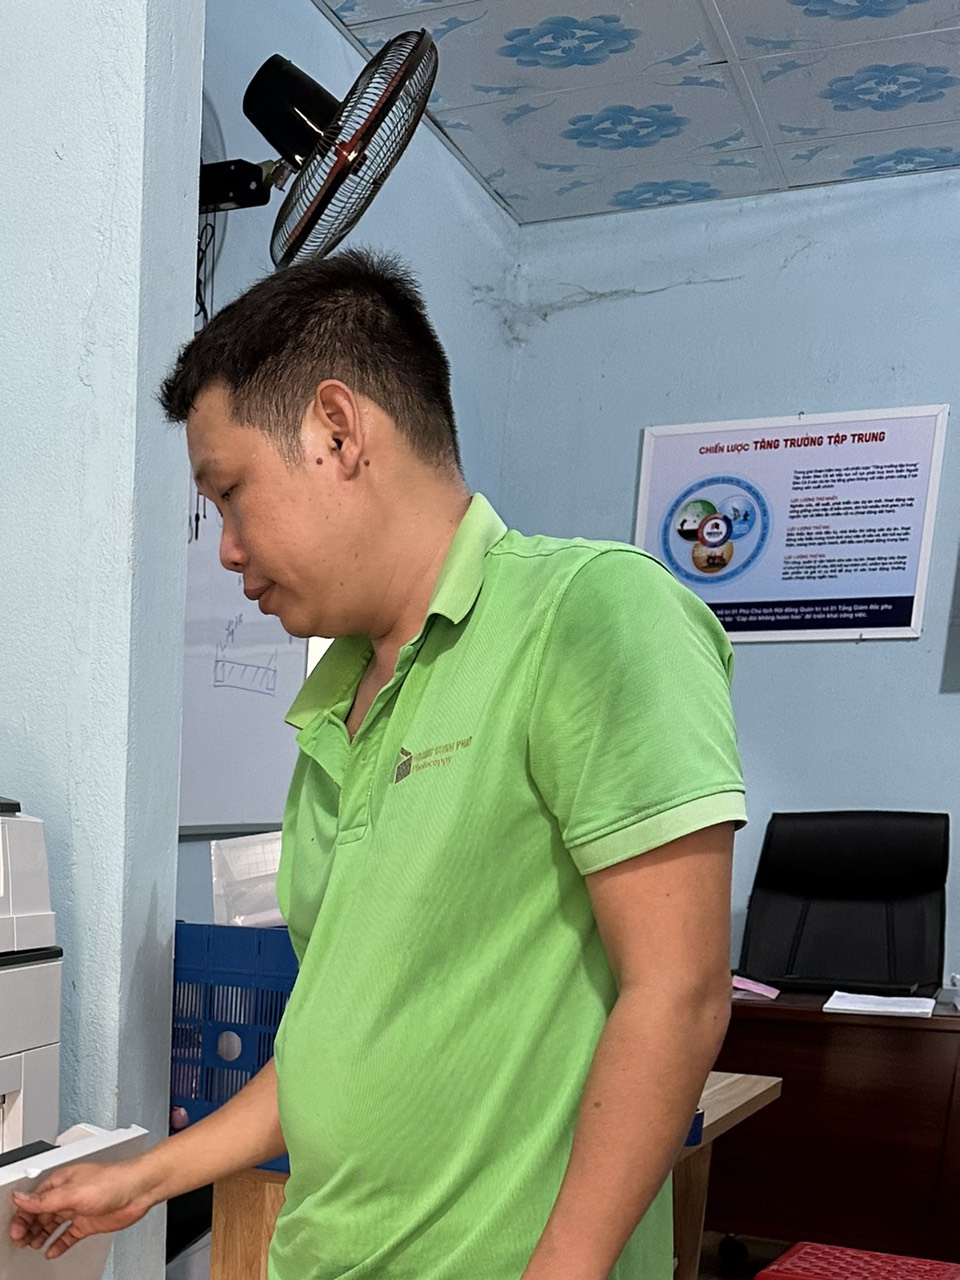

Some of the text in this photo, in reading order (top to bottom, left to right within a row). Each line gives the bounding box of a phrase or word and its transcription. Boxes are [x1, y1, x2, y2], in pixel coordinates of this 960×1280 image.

[699, 442, 725, 454] CHIẾN
[726, 443, 750, 455] LƯỢC
[827, 433, 847, 447] TẬP
[850, 431, 886, 443] TRUNG
